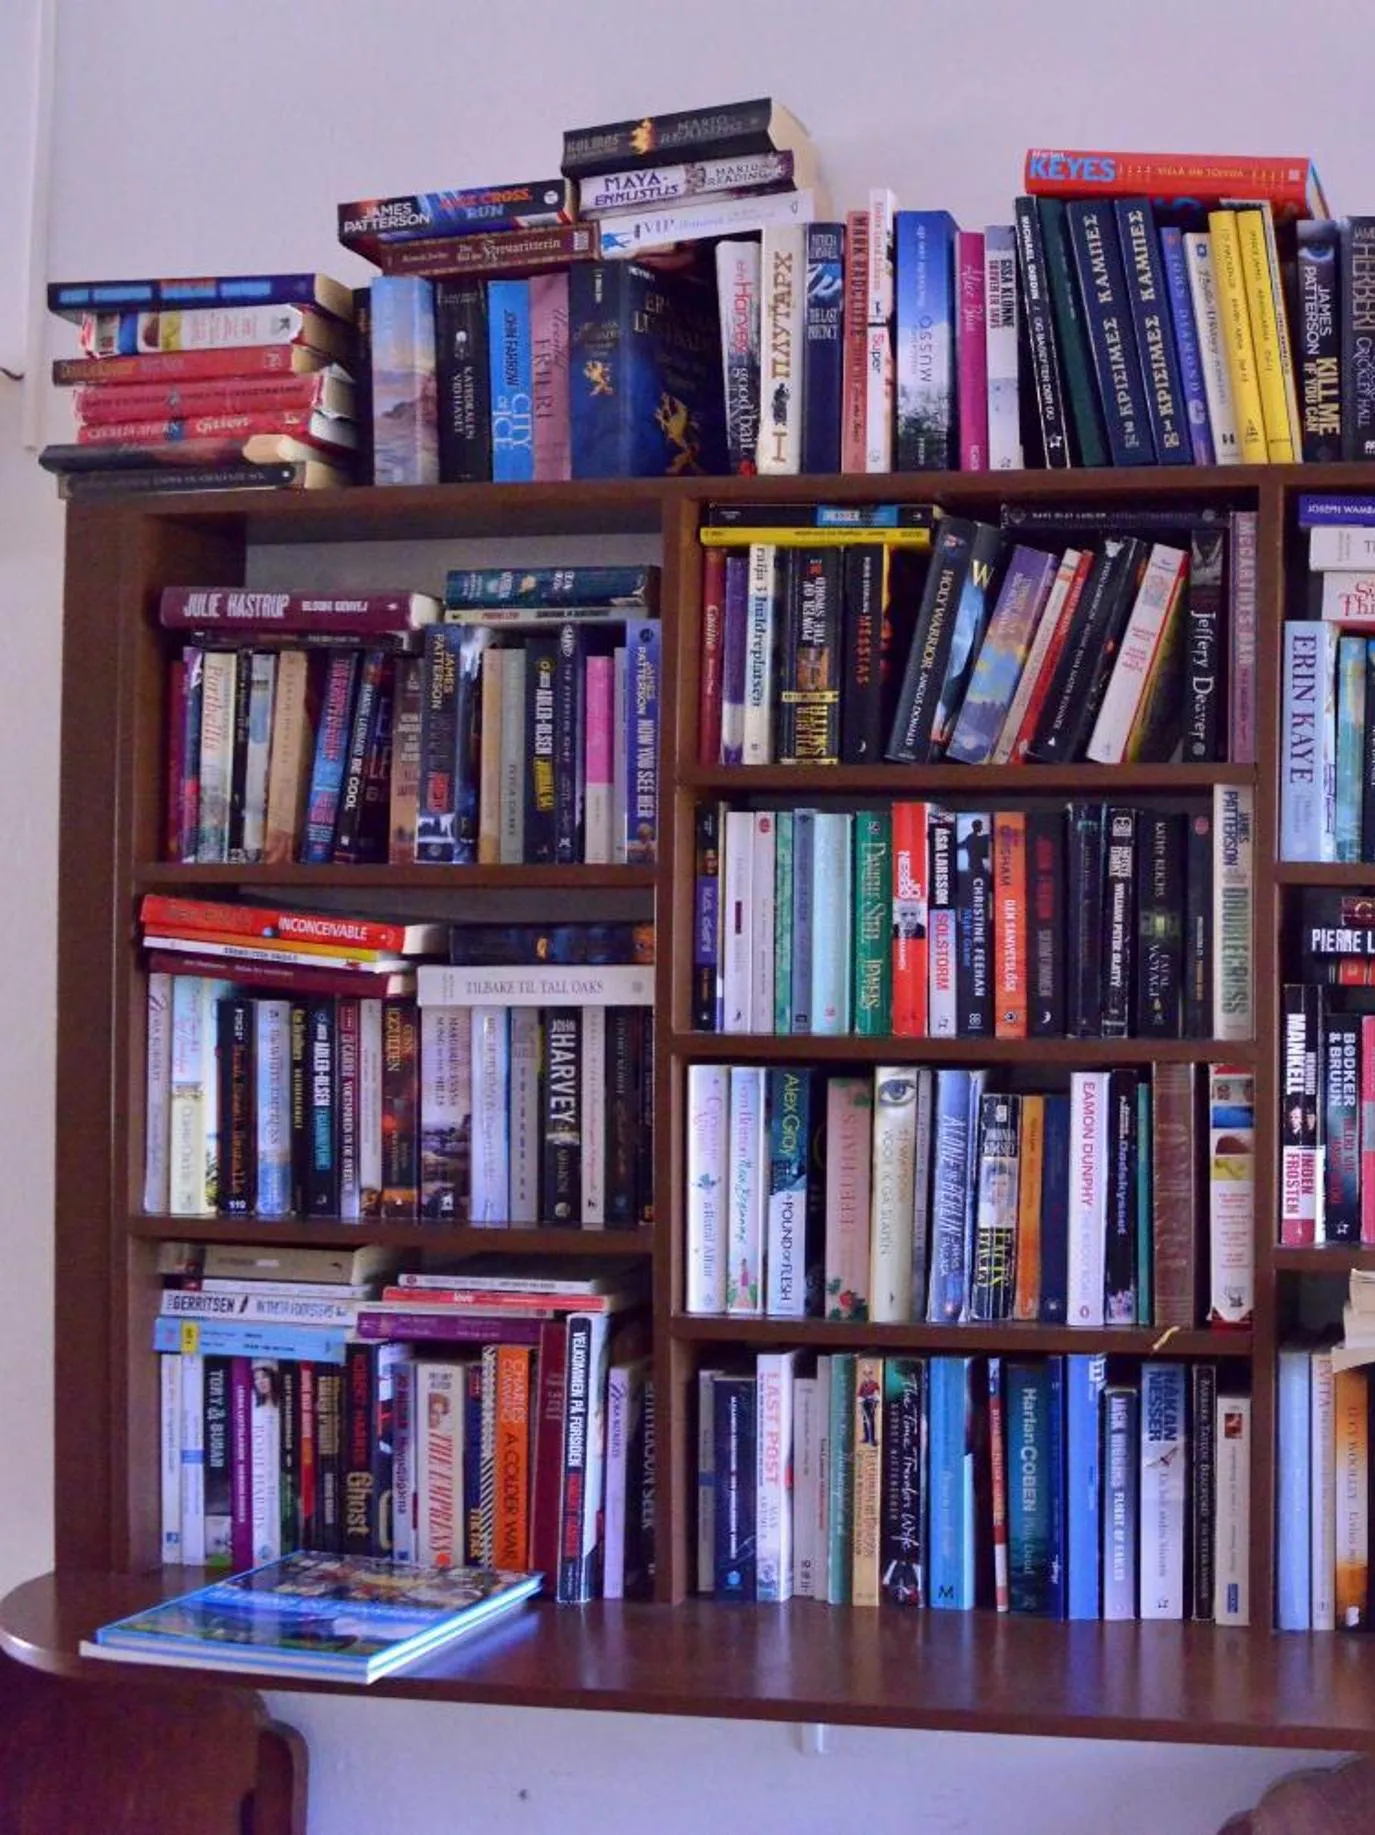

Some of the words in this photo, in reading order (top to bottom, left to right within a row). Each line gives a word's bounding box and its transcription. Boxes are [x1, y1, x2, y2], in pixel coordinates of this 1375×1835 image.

[1029, 156, 1117, 183] KEYES
[343, 215, 431, 234] PATTERSON
[366, 203, 413, 220] JAMES
[851, 215, 869, 255] MARK
[1083, 213, 1114, 304] ΚΑΜΠΕΣ
[1128, 210, 1156, 302] ΚΑΜΠΕΣ
[771, 251, 794, 380] ПЛУТАРХ
[1303, 265, 1320, 356] PATTERSON
[1319, 285, 1332, 337] JAMES
[871, 333, 885, 374] Super
[918, 314, 935, 383] MUSSO
[1302, 363, 1316, 377] IF
[1303, 378, 1317, 403] YOU
[1316, 356, 1339, 400] KILL
[492, 410, 513, 451] ICE
[511, 393, 532, 451] CITY
[1305, 406, 1319, 432] CAN
[1319, 403, 1341, 437] ME
[1356, 398, 1371, 429] HALL
[183, 593, 222, 617] JULIE
[935, 568, 956, 605] HOLY
[920, 607, 946, 670] WARRIOR
[1191, 609, 1217, 668] Jeffery
[431, 633, 445, 710] PATTERSON
[443, 651, 455, 694] JAMES
[637, 646, 648, 716] PATTERSON
[1292, 633, 1317, 703] ERIN
[637, 719, 655, 745] NOW
[904, 704, 924, 747] DONALD
[1189, 675, 1215, 741] Deaver
[351, 758, 363, 775] BE
[637, 746, 655, 768] YOU
[1290, 711, 1315, 784] KAYE
[344, 776, 360, 811] COOL
[637, 770, 655, 793] SEE
[637, 795, 655, 818] HER
[1223, 790, 1239, 866] PATTERSON
[936, 852, 949, 905] LARSSON
[277, 914, 369, 941] INCONCEIVABLE
[973, 877, 986, 943] CHRISTINE
[935, 911, 950, 992] SOLSTORM
[1310, 927, 1362, 954] PIERRE
[974, 948, 986, 997] FEEHAN
[1286, 1012, 1306, 1096] MANKELL
[1329, 1031, 1343, 1043] &
[550, 1033, 576, 1124] HARVEY
[783, 1072, 800, 1113] Alex
[1329, 1045, 1343, 1107] BRUUN
[1342, 1032, 1357, 1107] BØDKER
[1081, 1080, 1097, 1141] EAMON
[1080, 1142, 1095, 1208] DUNPHY
[1285, 1152, 1301, 1215] FROSTEN
[1301, 1152, 1316, 1195] INDEN
[781, 1200, 793, 1249] POUND
[568, 1331, 587, 1398] VELKOMMEN
[569, 1399, 585, 1414] PÅ
[765, 1370, 780, 1423] LAST
[1023, 1387, 1037, 1445] Harlan
[1111, 1397, 1127, 1431] JACK
[1149, 1369, 1164, 1442] NESSER
[503, 1431, 520, 1448] A
[765, 1430, 780, 1486] POST
[347, 1471, 375, 1536] Ghost
[503, 1451, 520, 1516] COLDER
[1019, 1445, 1037, 1512] COBEN
[502, 1519, 519, 1563] WAR
